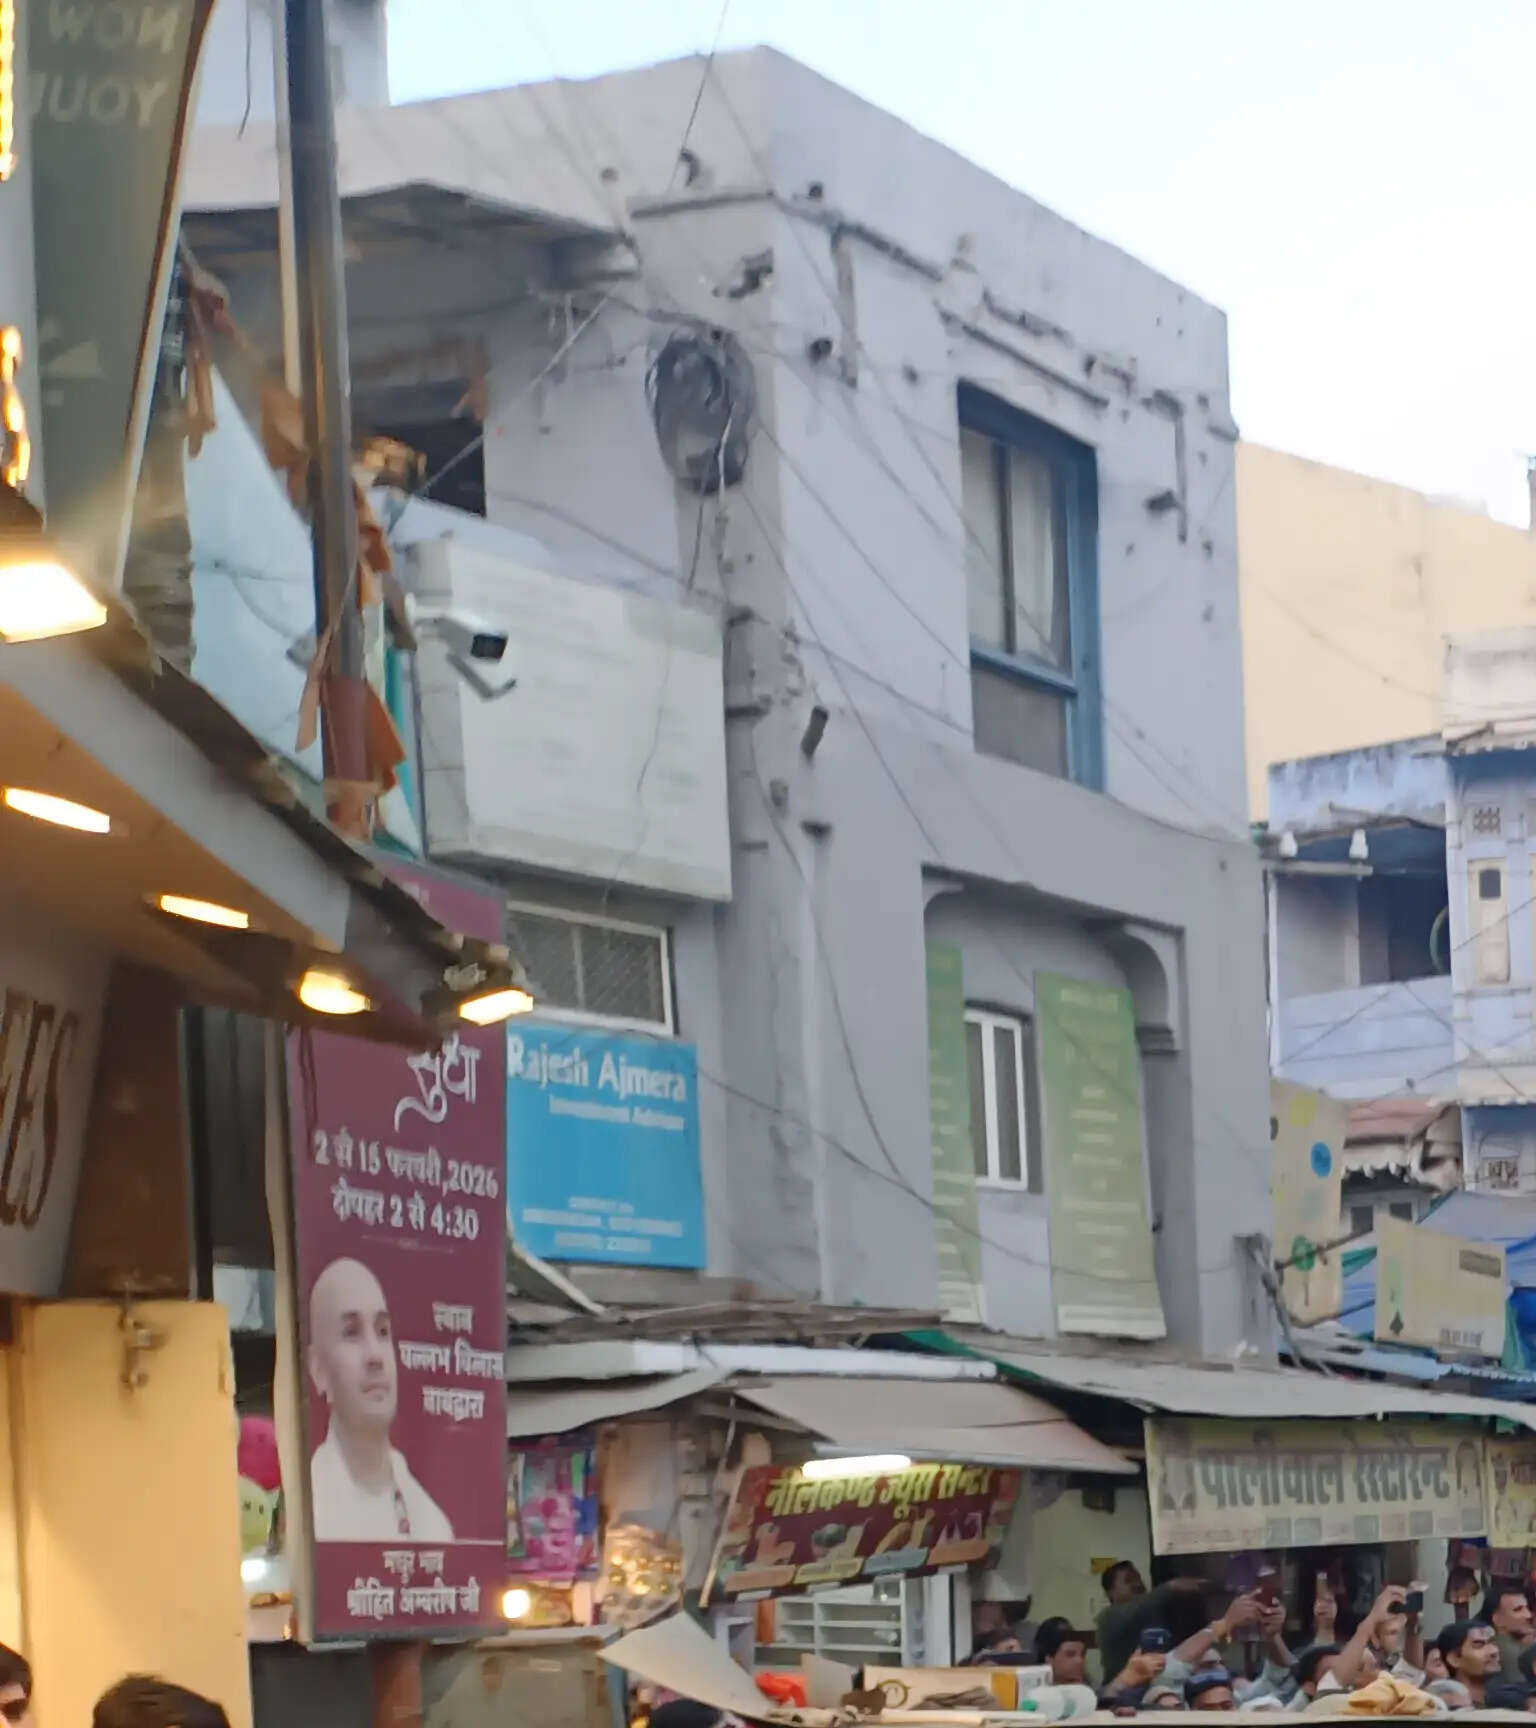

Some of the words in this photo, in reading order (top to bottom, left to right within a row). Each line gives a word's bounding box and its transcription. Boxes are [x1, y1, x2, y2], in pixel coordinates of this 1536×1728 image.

[507, 1034, 589, 1089] Rajesh
[598, 1050, 686, 1101] Ajmera
[314, 1129, 331, 1165] 2
[360, 1140, 382, 1176] 15
[391, 1195, 404, 1228] 2
[431, 1203, 479, 1241] 4:30
